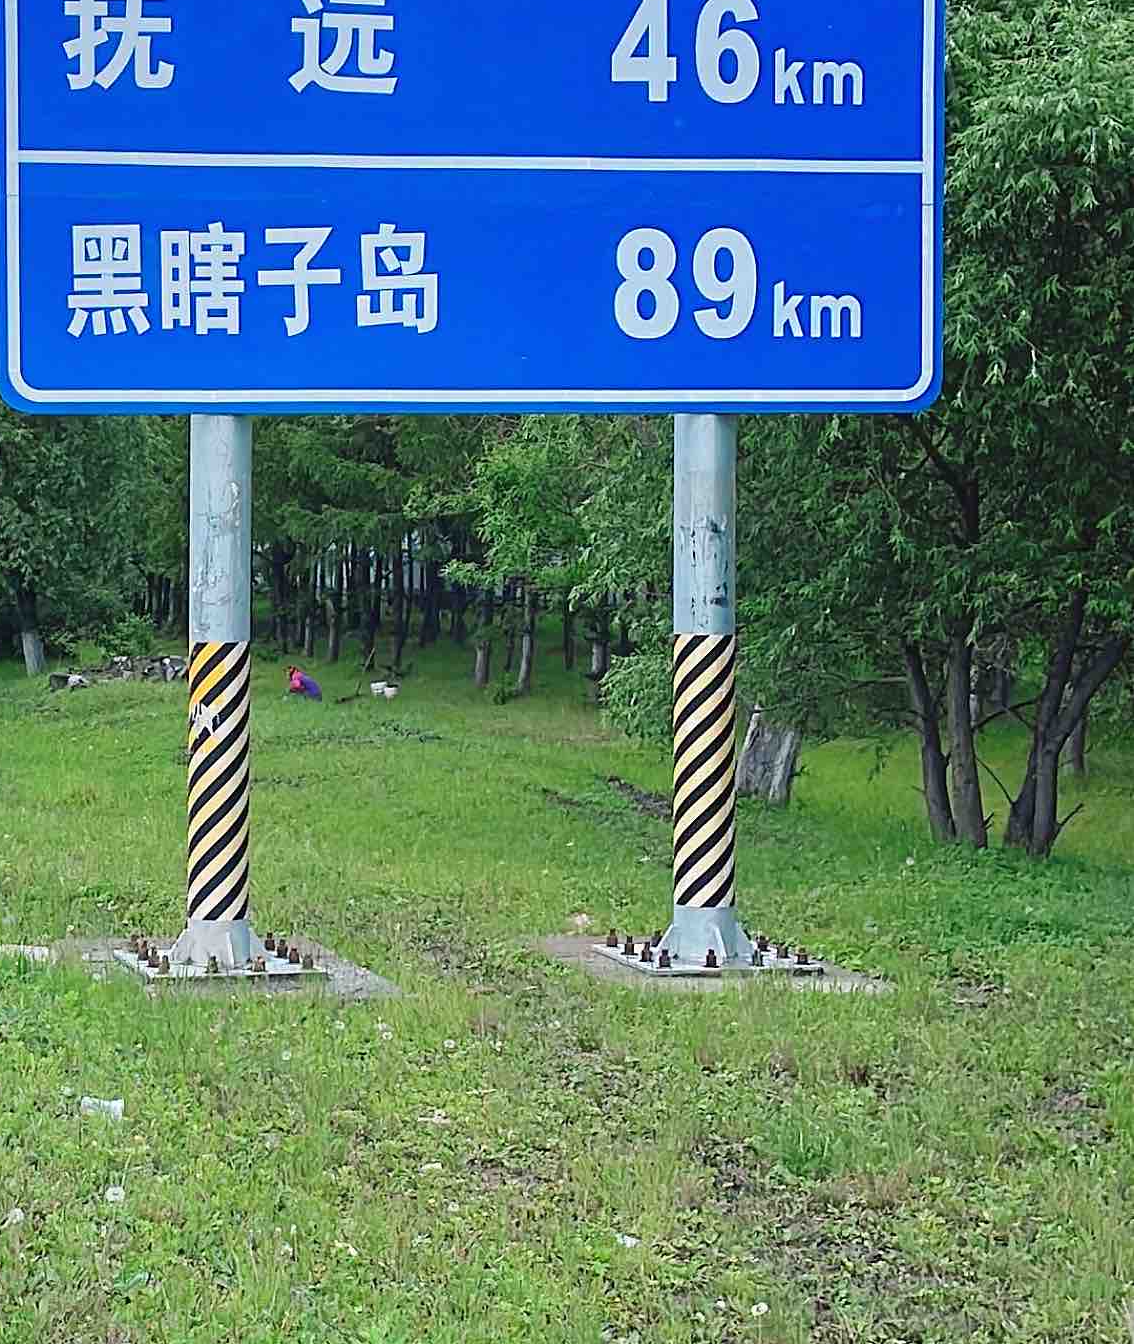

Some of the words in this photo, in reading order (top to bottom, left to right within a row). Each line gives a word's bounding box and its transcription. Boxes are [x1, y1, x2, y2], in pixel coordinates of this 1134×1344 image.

[67, 221, 440, 338] 黑瞎子岛
[614, 227, 862, 340] 89km
